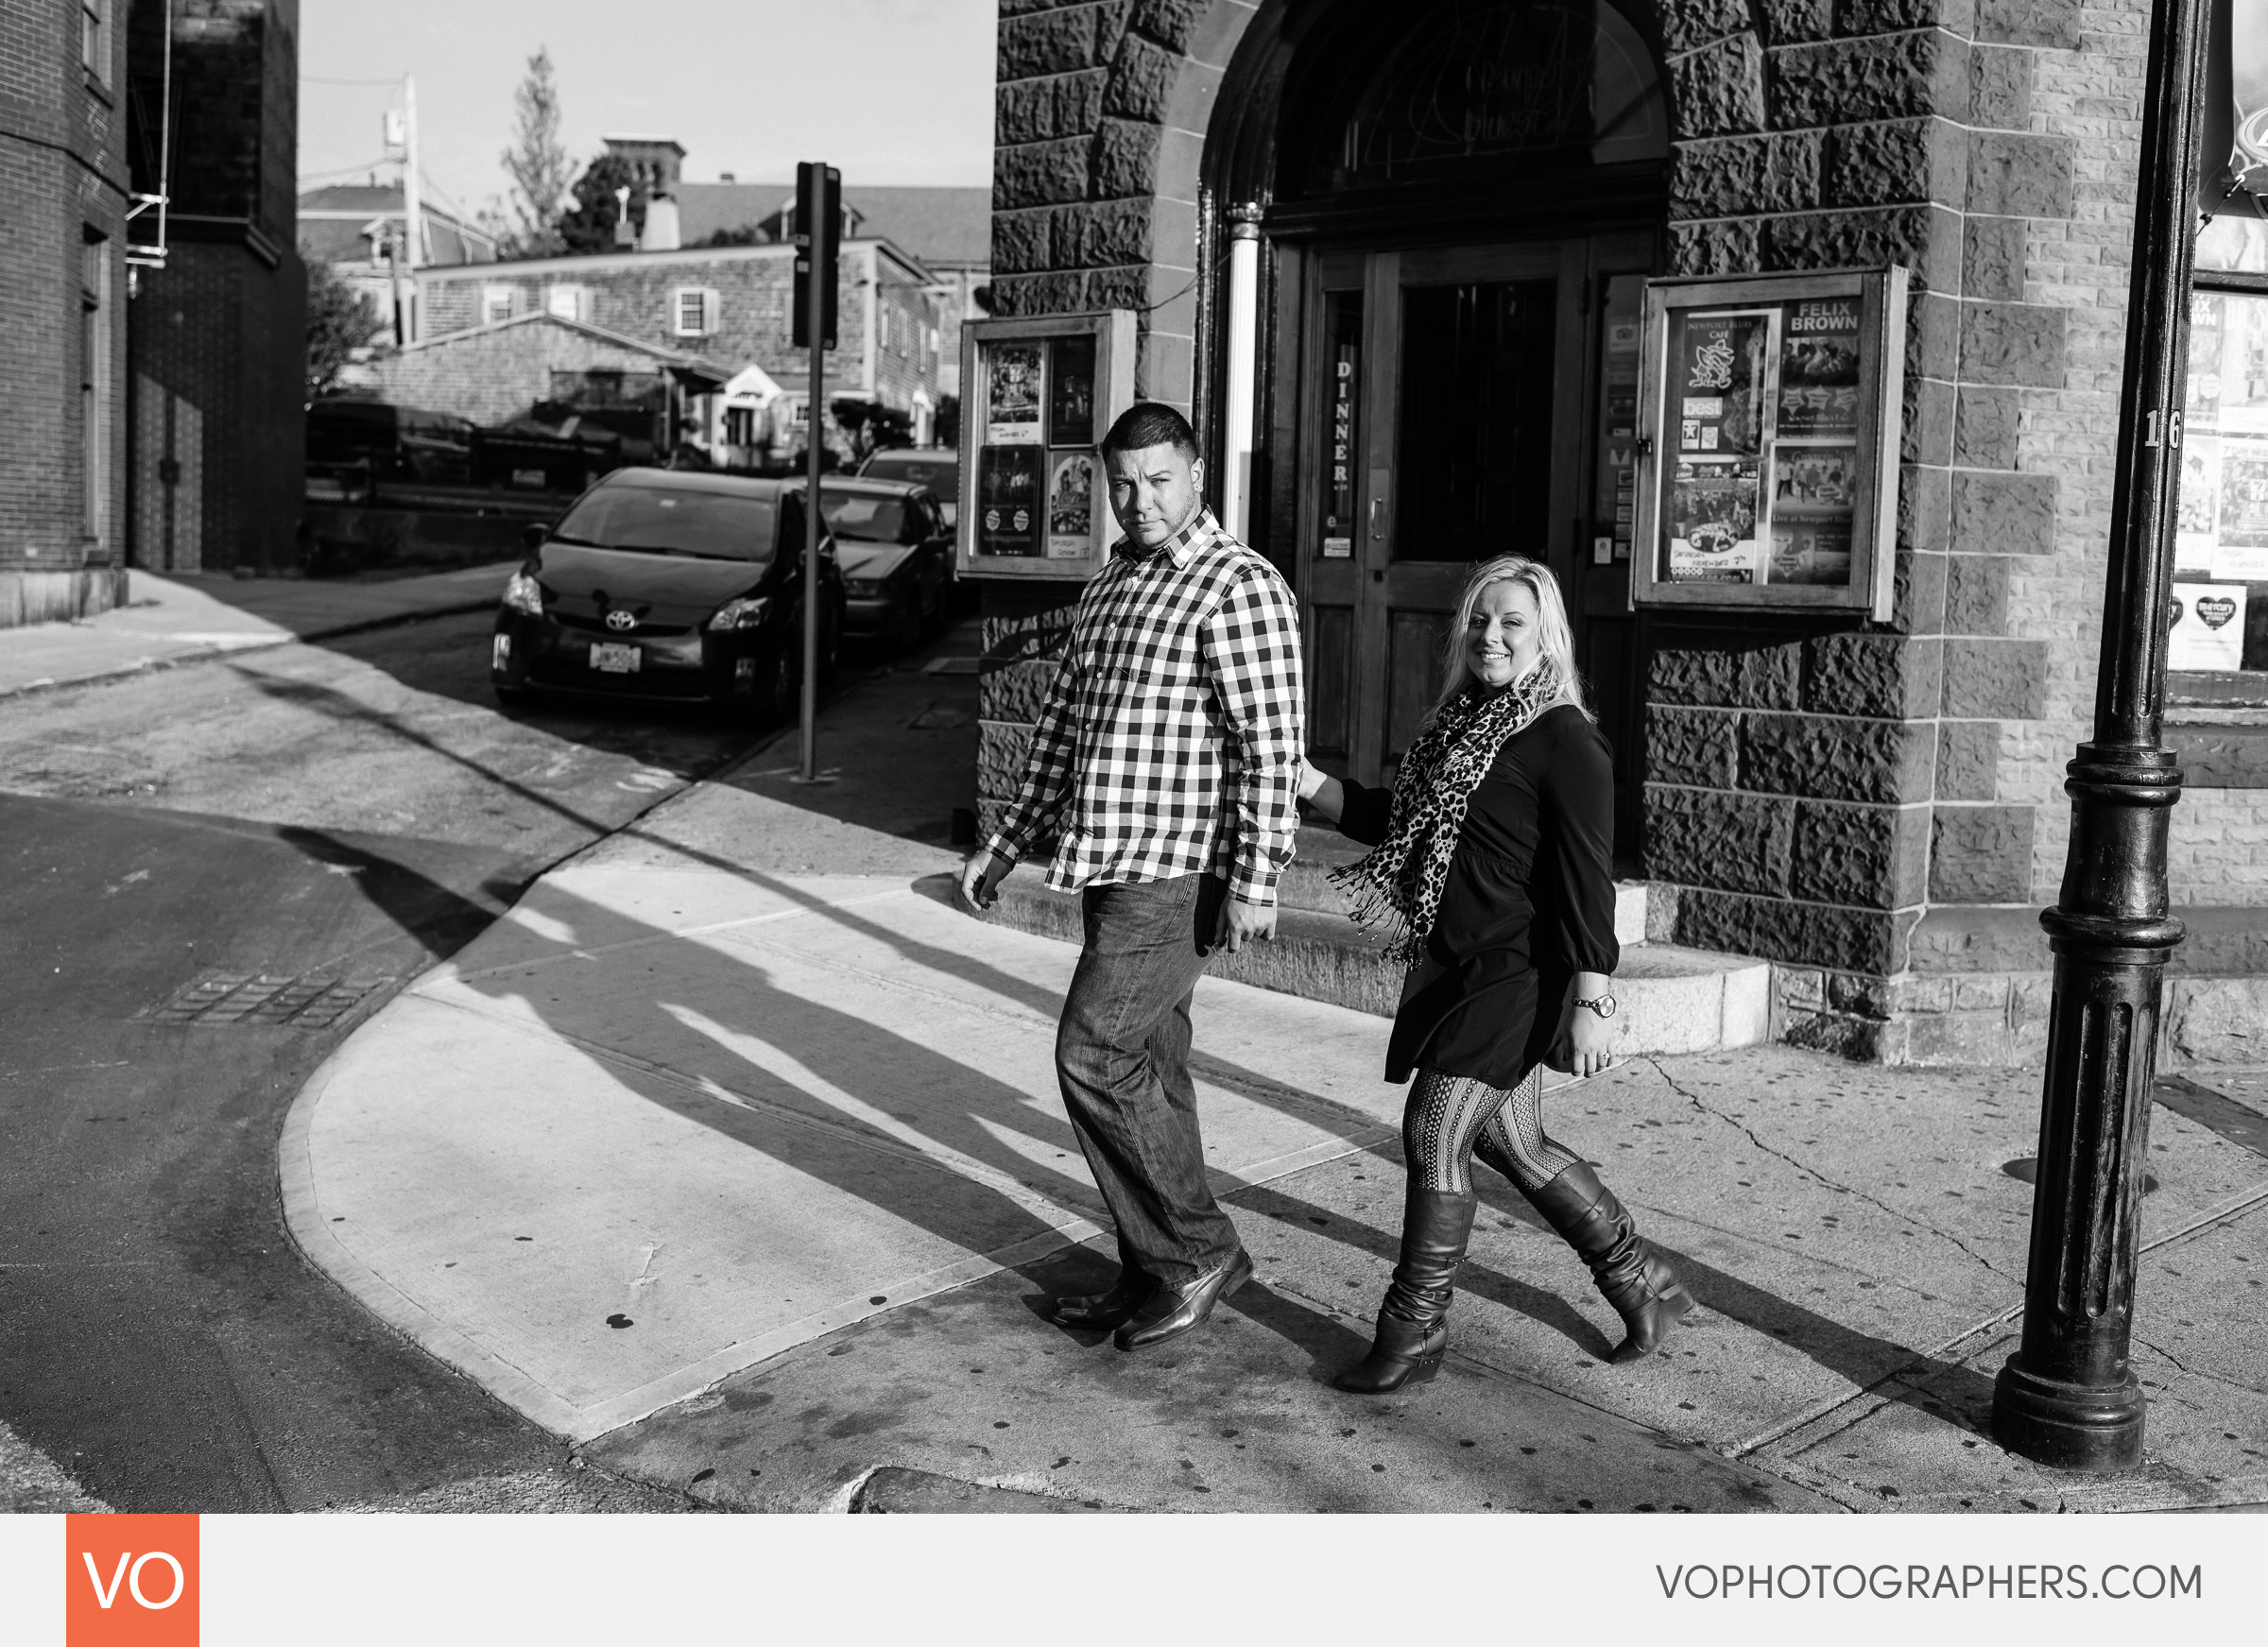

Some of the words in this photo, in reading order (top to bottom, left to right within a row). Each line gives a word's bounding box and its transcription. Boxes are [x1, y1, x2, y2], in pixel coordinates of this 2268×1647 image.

[1798, 302, 1850, 317] FELIX
[1791, 316, 1859, 331] BROWN
[1687, 401, 1722, 415] best
[1333, 361, 1351, 482] DINNER
[2144, 409, 2181, 450] 16
[2198, 602, 2234, 614] mercury
